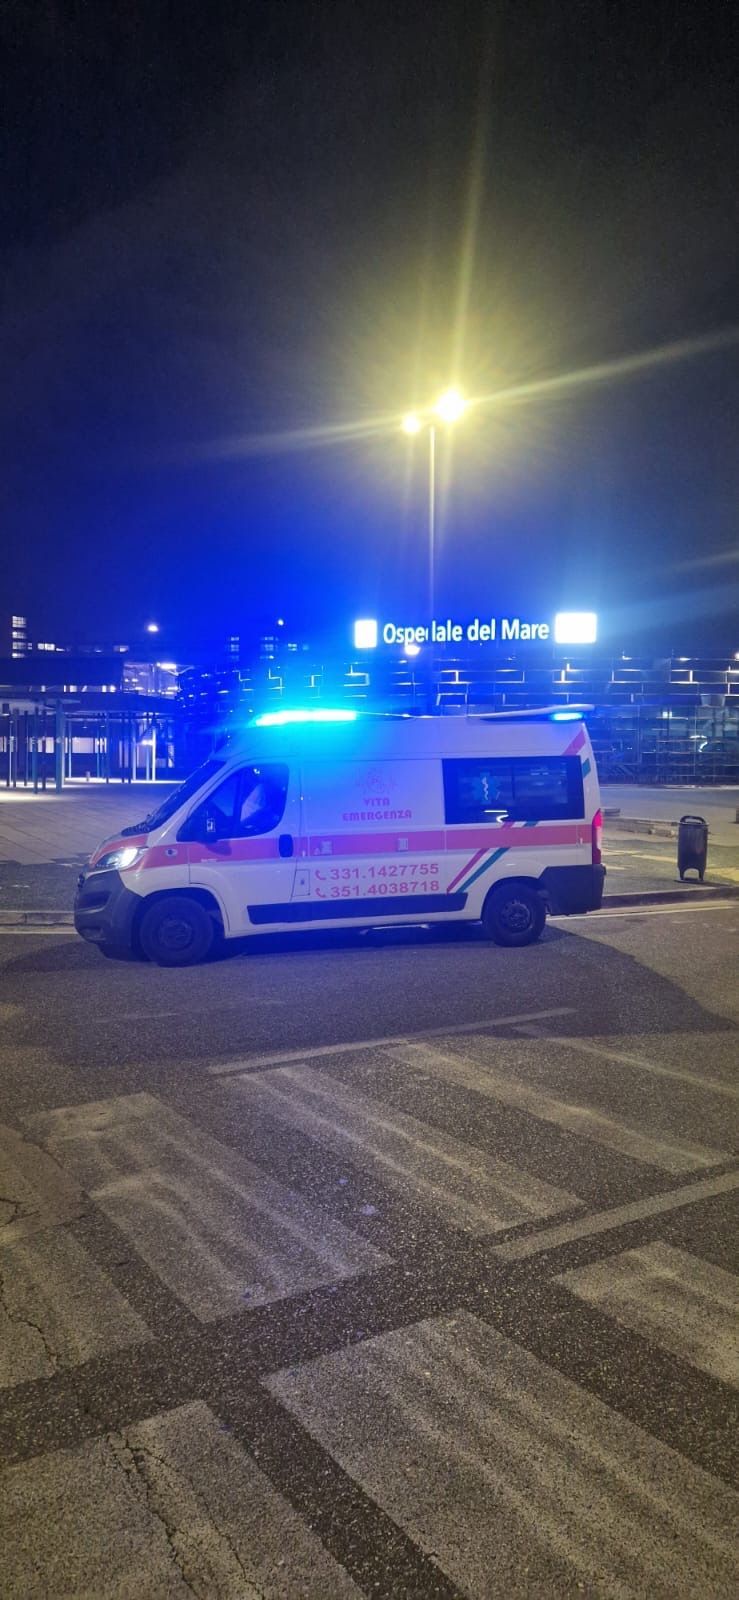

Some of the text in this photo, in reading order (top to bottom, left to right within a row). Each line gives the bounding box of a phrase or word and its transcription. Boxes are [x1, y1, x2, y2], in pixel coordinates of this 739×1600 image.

[467, 618, 496, 641] del
[501, 618, 549, 641] Mare
[363, 797, 391, 807] VITA
[342, 809, 412, 822] EMERGENZA
[330, 863, 439, 881] 331.1427755
[330, 880, 440, 898] 351.4038718
